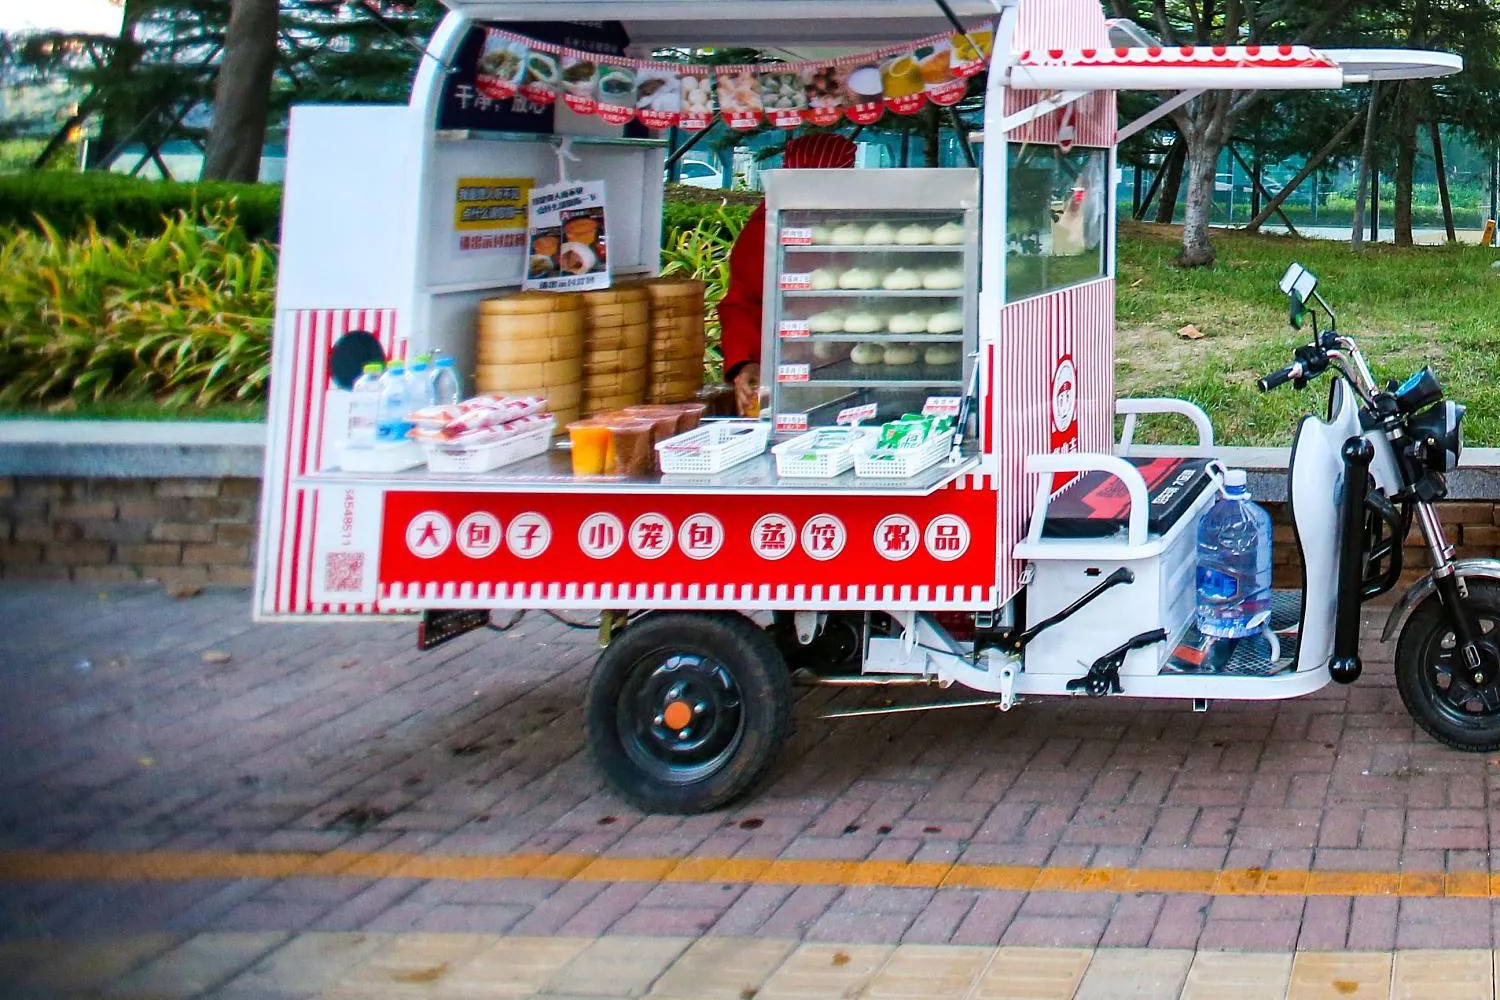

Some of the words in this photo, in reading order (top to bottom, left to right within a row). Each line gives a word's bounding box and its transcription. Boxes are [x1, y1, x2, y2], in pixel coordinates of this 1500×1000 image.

[412, 521, 545, 553] 大包子
[585, 521, 717, 553] 小笼包
[757, 521, 838, 554] 蒸饺
[880, 521, 964, 554] 粥品
